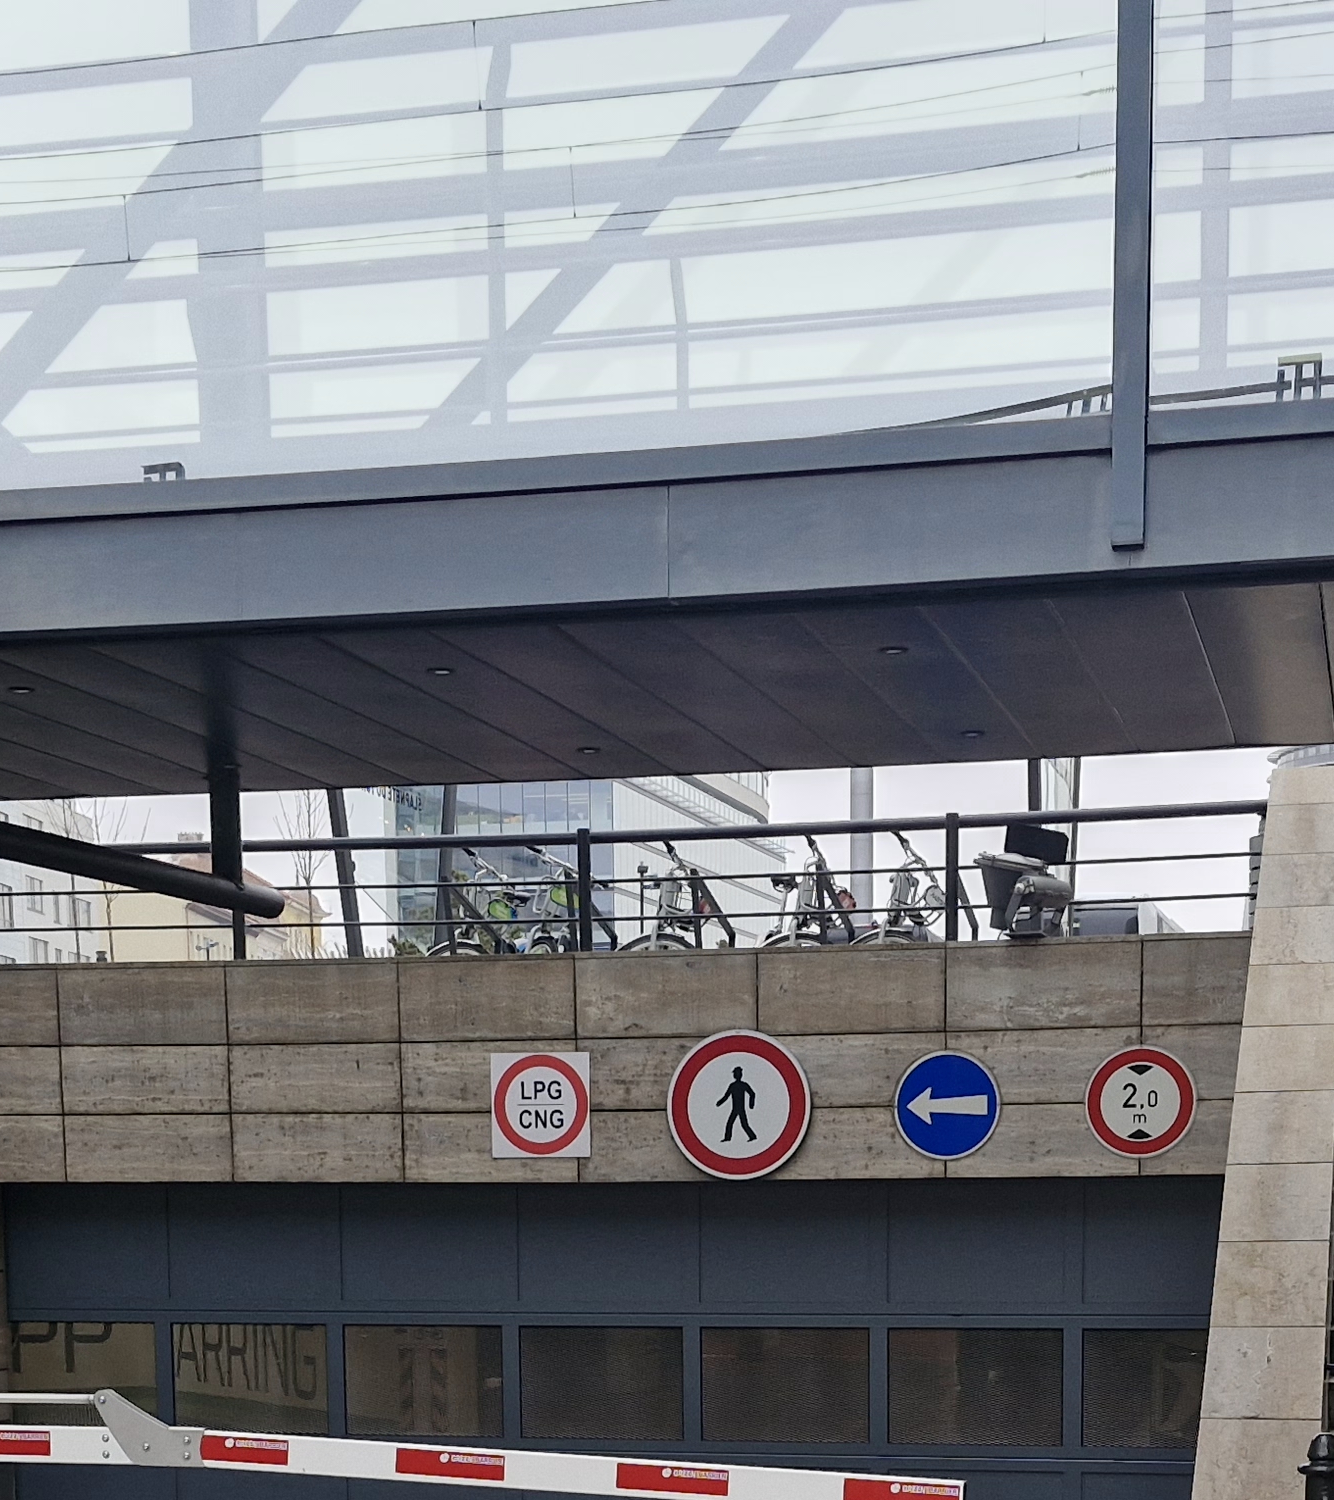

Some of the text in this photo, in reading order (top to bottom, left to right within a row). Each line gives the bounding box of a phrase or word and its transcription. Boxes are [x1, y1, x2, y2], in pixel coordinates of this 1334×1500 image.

[520, 1080, 562, 1100] LPG
[1122, 1082, 1158, 1110] 2,0
[519, 1109, 564, 1129] CNG
[1132, 1113, 1147, 1124] m
